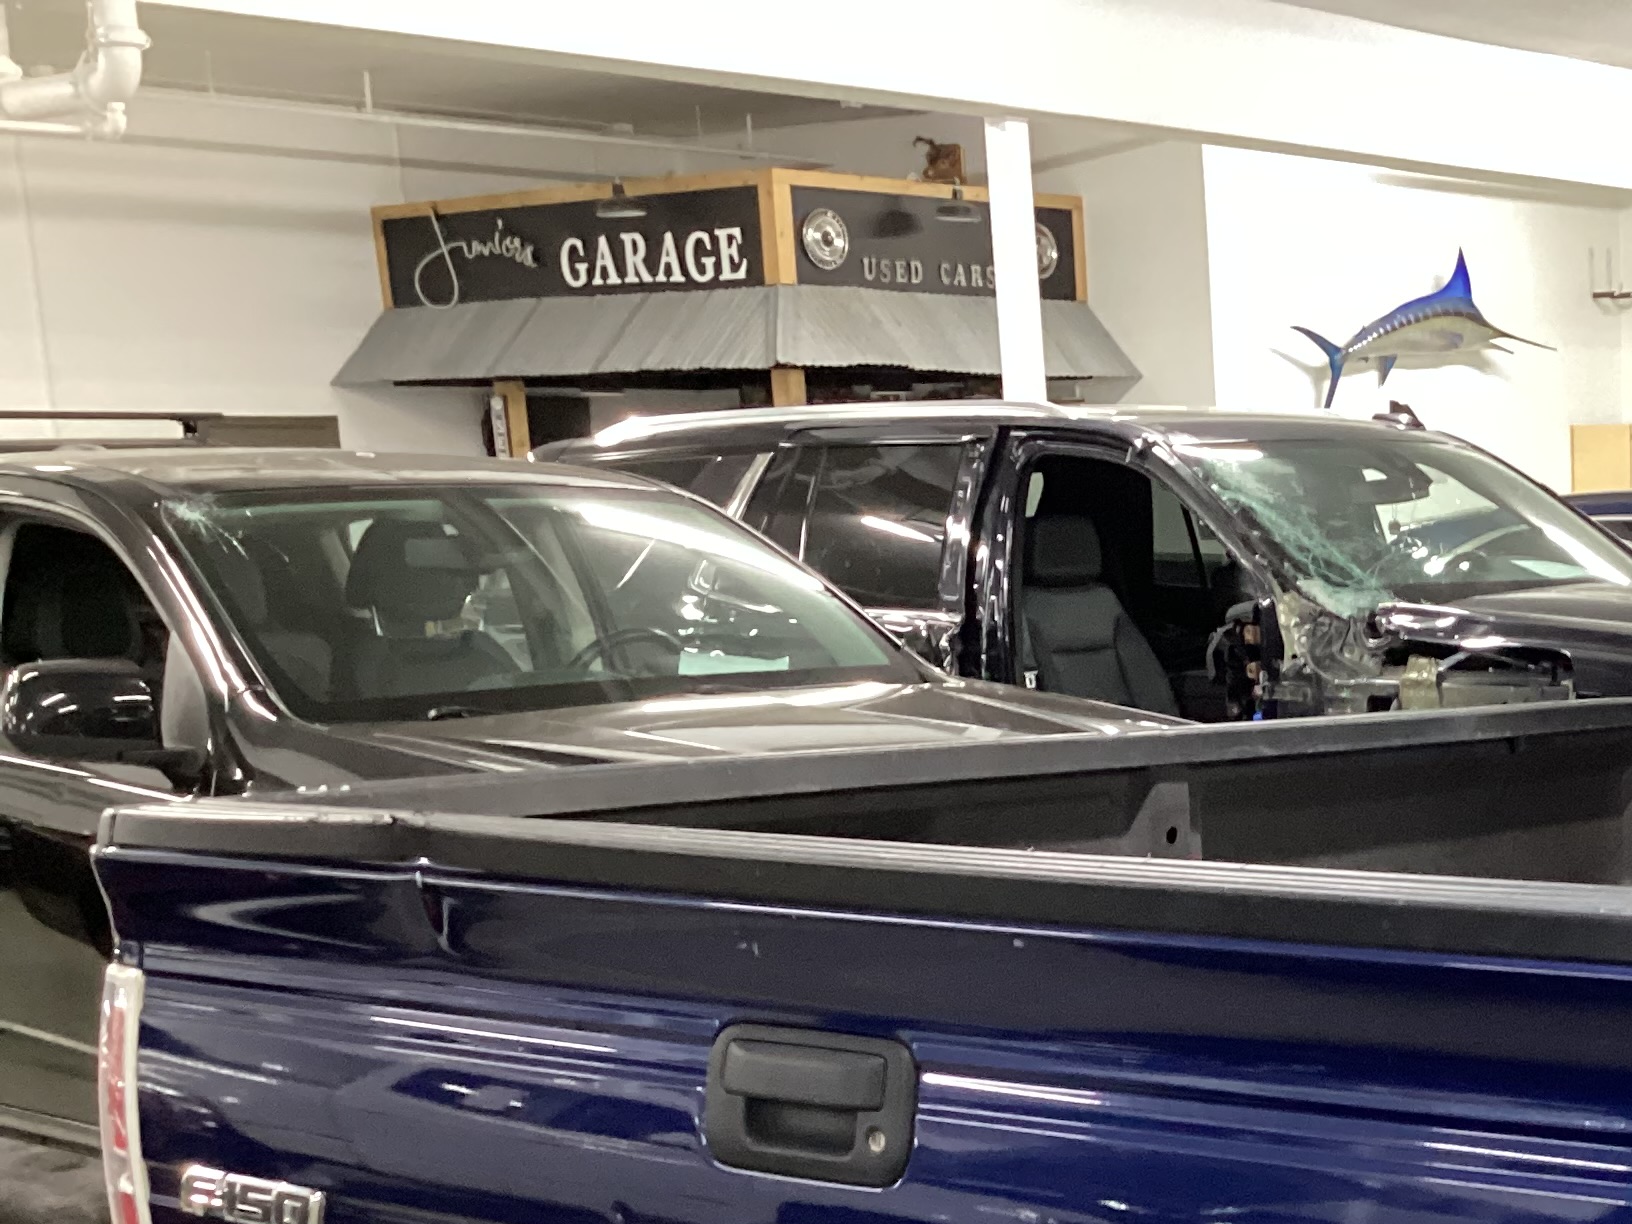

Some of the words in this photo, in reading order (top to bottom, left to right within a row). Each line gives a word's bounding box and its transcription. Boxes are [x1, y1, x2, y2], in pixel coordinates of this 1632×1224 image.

[559, 226, 748, 288] GARAGE
[861, 256, 924, 284] USED
[939, 260, 996, 289] CARS
